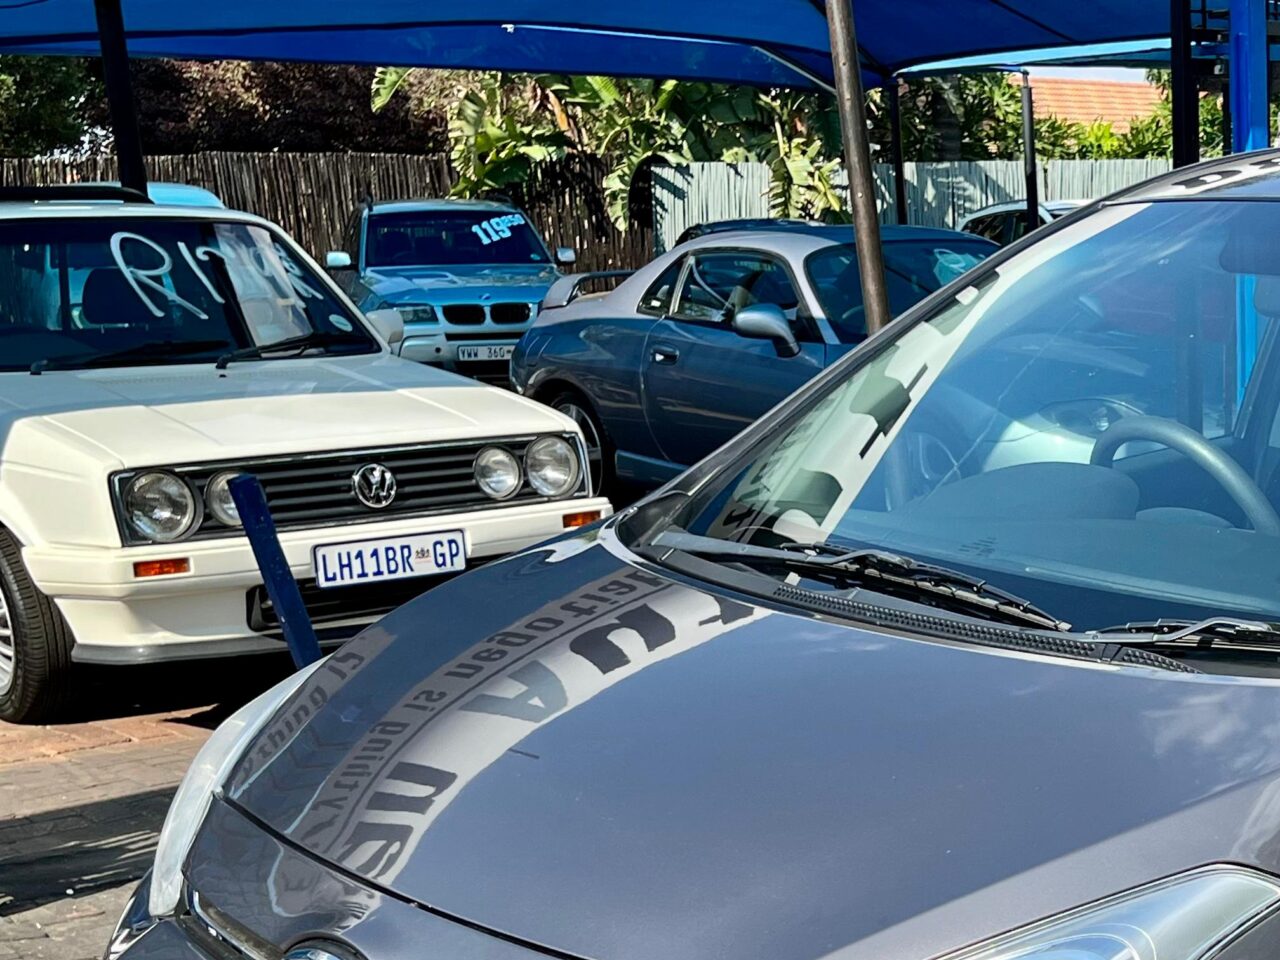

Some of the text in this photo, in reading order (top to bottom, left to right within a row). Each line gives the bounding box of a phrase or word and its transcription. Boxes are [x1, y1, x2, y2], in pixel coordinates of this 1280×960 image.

[487, 346, 505, 359] 360
[321, 543, 415, 583] LH11BR
[432, 538, 460, 568] GP
